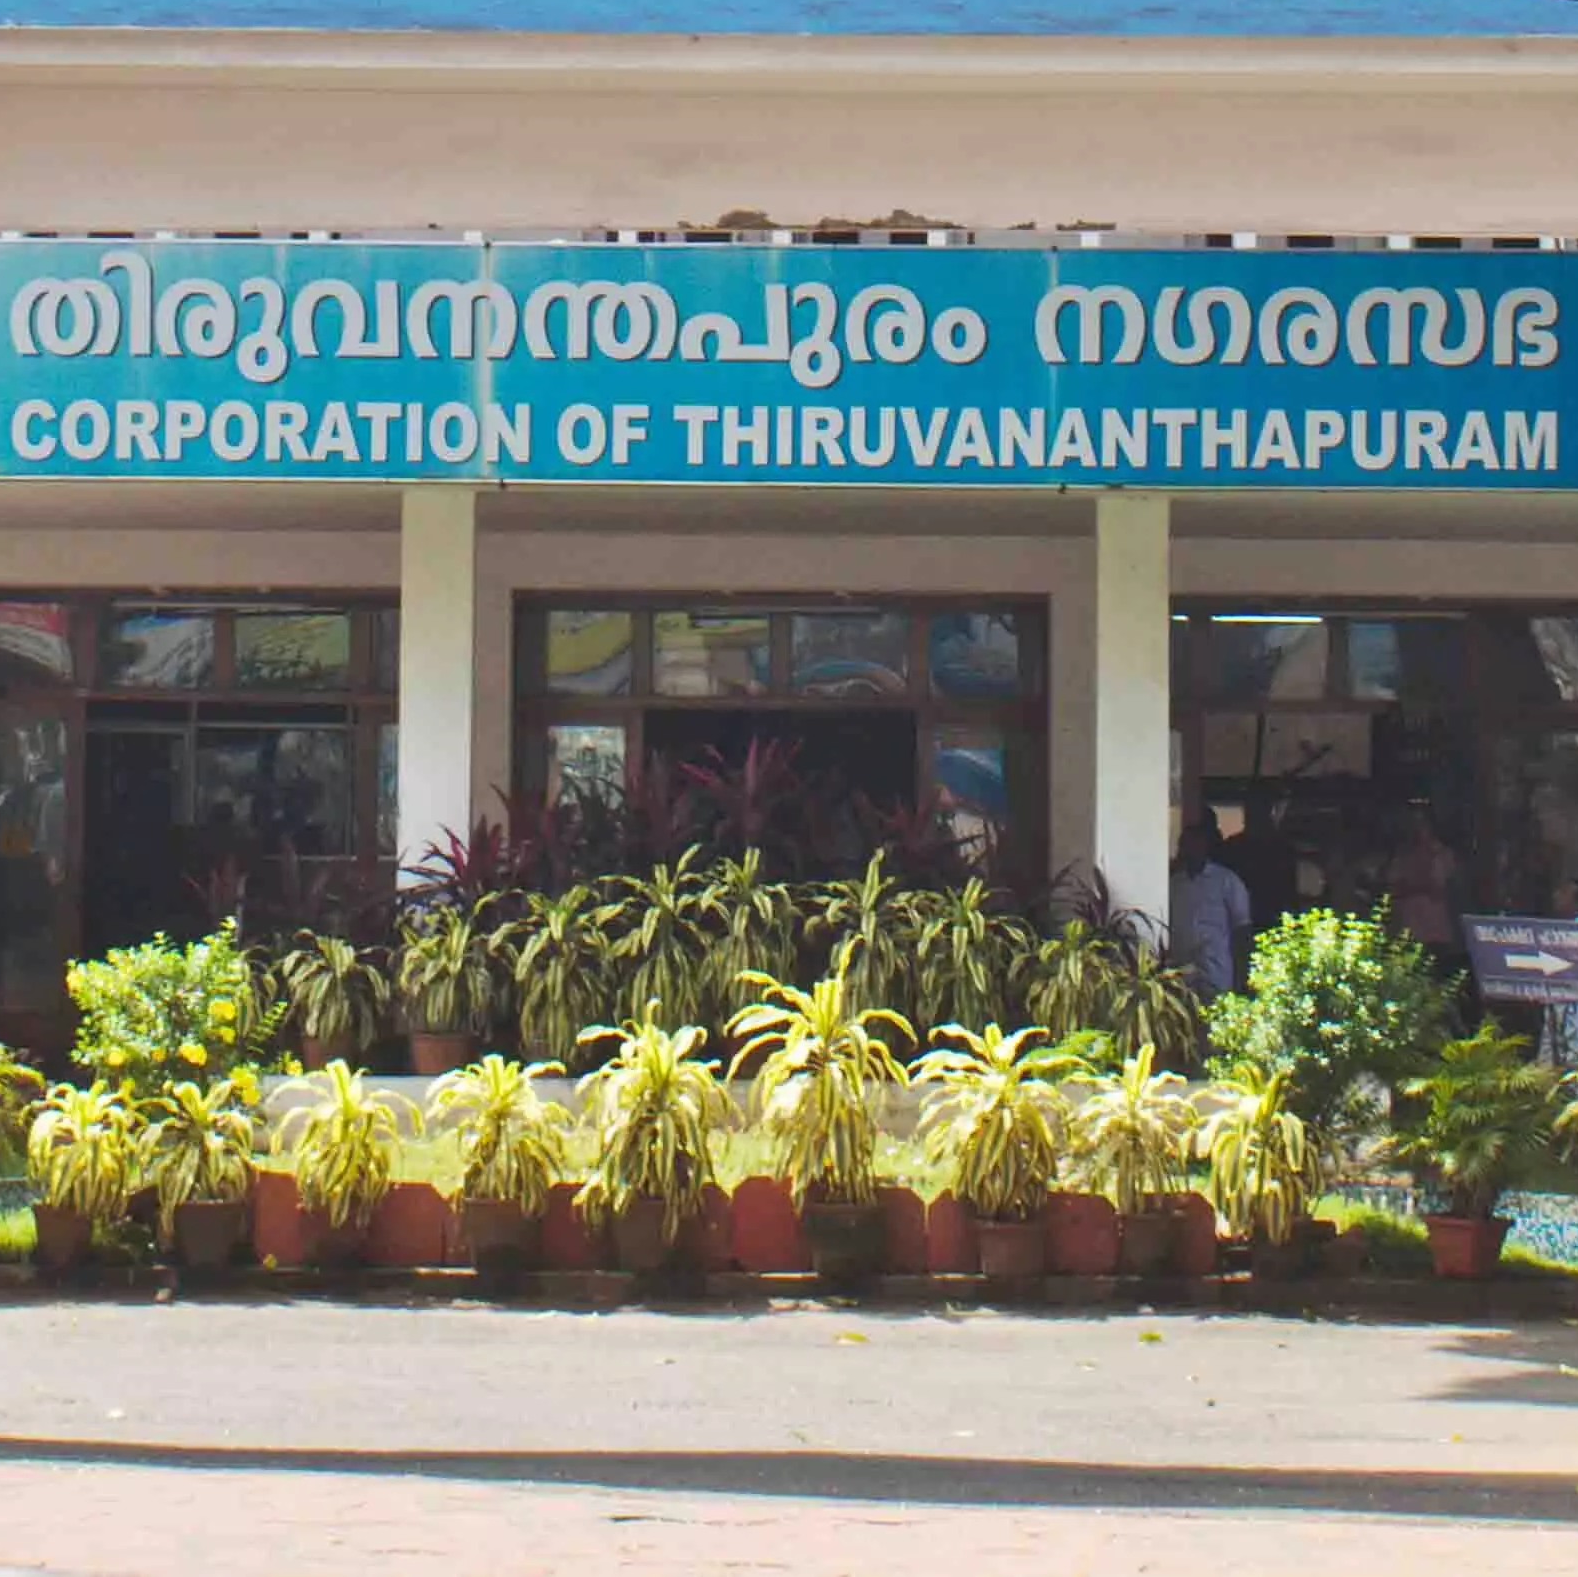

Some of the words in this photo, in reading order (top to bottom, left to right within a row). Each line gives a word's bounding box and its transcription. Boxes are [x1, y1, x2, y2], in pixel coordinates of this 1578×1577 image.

[9, 252, 987, 388] തിരുവനന്തപുരം
[1034, 284, 1560, 367] നഗരസഭ
[10, 399, 531, 464] CORPORATION
[557, 404, 650, 465] OF
[673, 405, 1559, 472] THIRUVANANTHAPURAM
